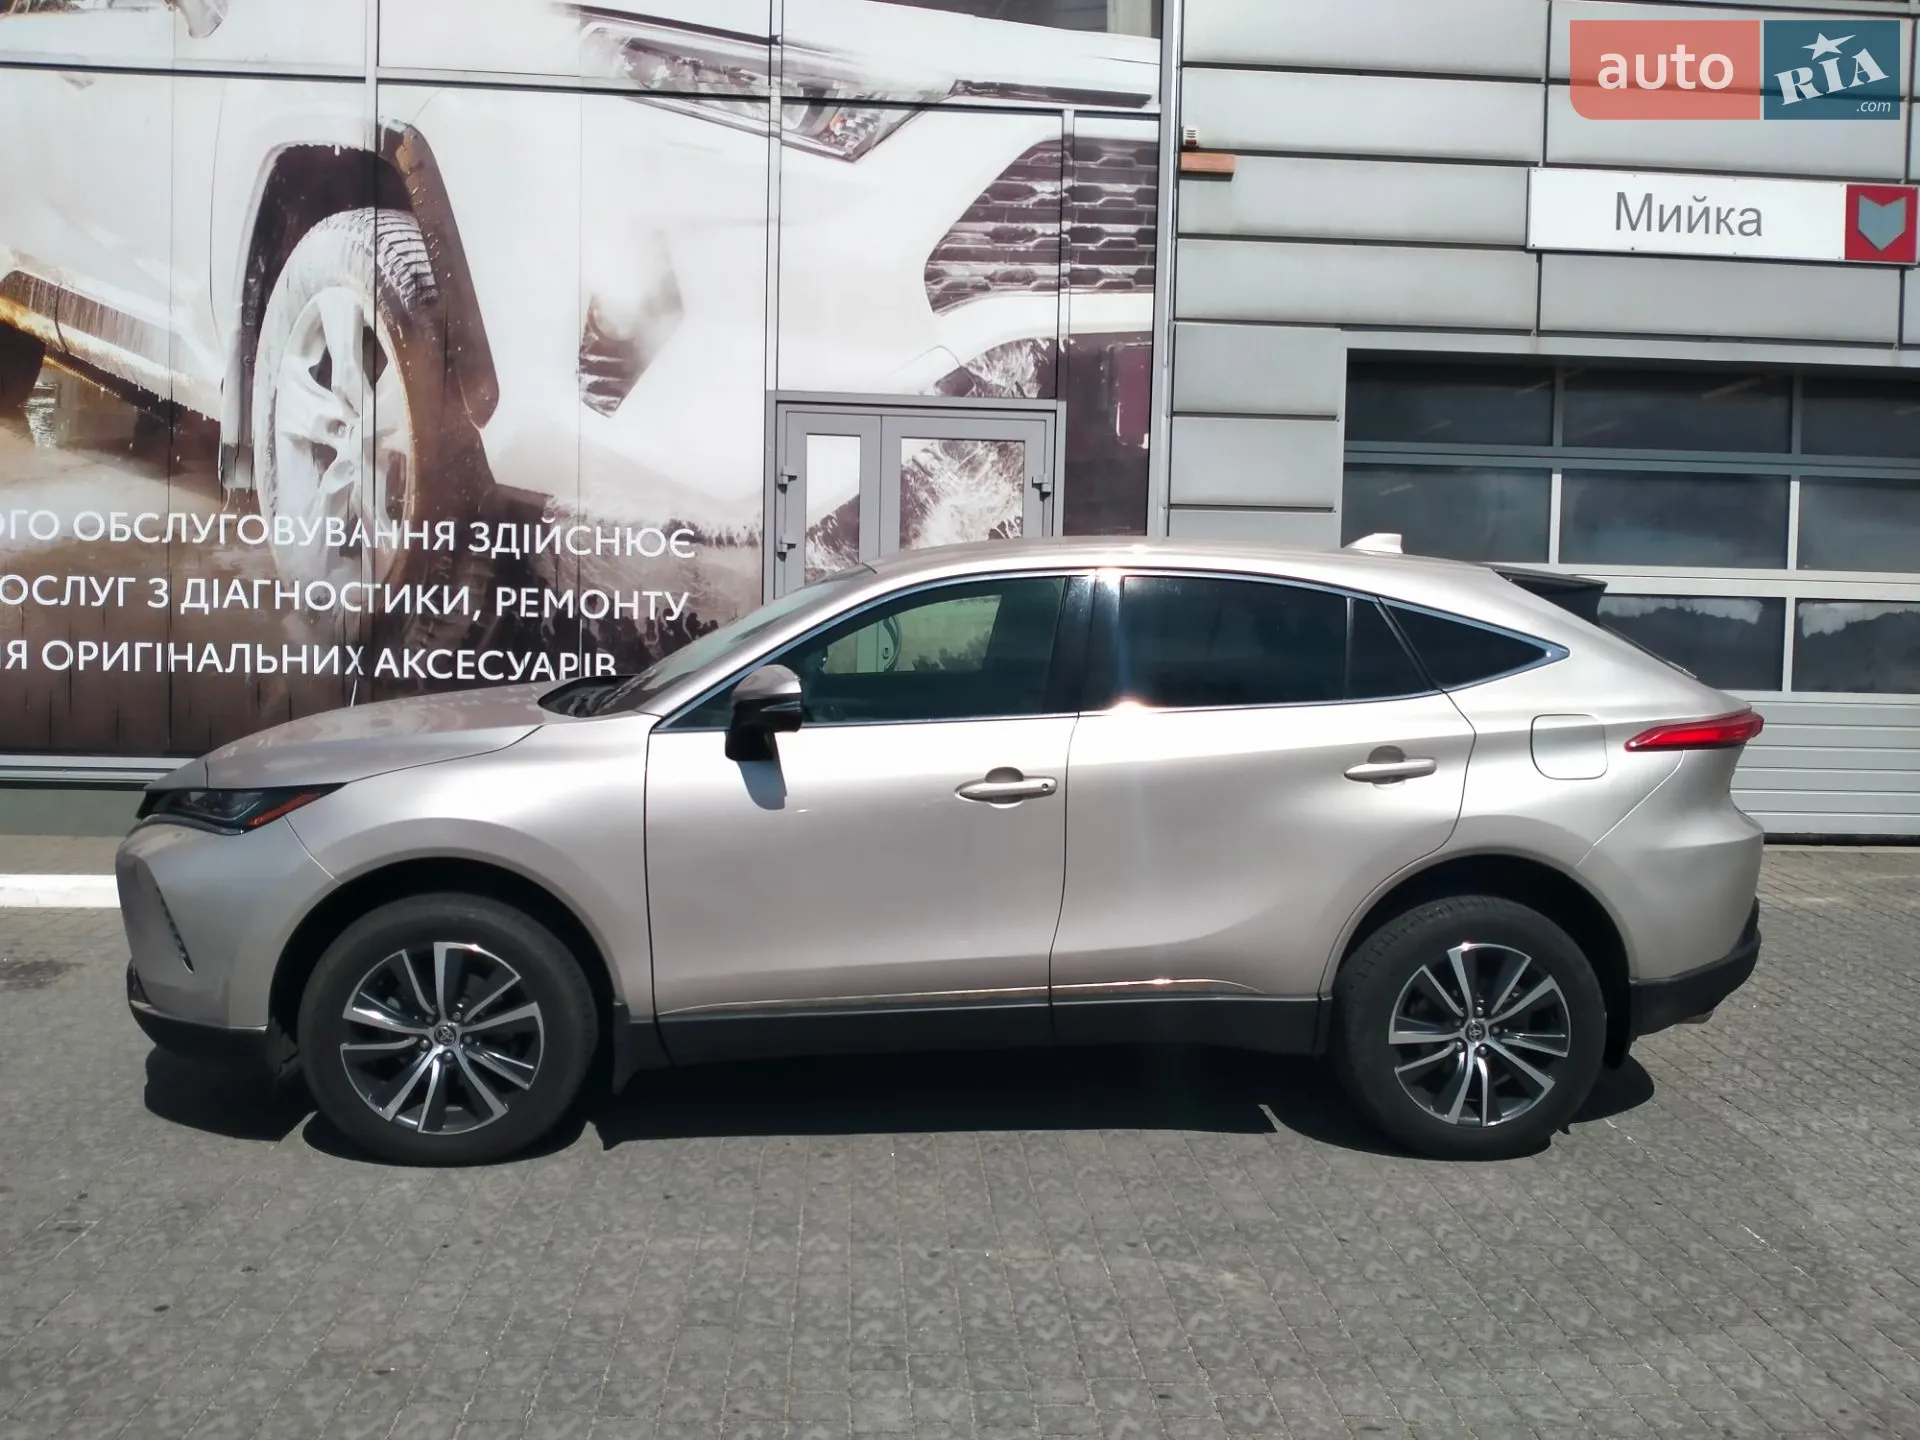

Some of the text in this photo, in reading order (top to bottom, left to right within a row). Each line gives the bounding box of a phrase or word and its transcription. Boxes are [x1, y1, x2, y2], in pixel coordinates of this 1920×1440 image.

[1615, 191, 1763, 237] Мийка
[0, 509, 696, 560] ГО ОБСЛУГОВУВАННЯ ЗДІЙСНЮЄ
[0, 574, 690, 622] ОСЛУГ З ДІАГНОСТИКИ, РЕМОНТУ
[0, 639, 617, 681] Я ОРИГІНАЛЬНИХ АКСЕСУАРІВ
